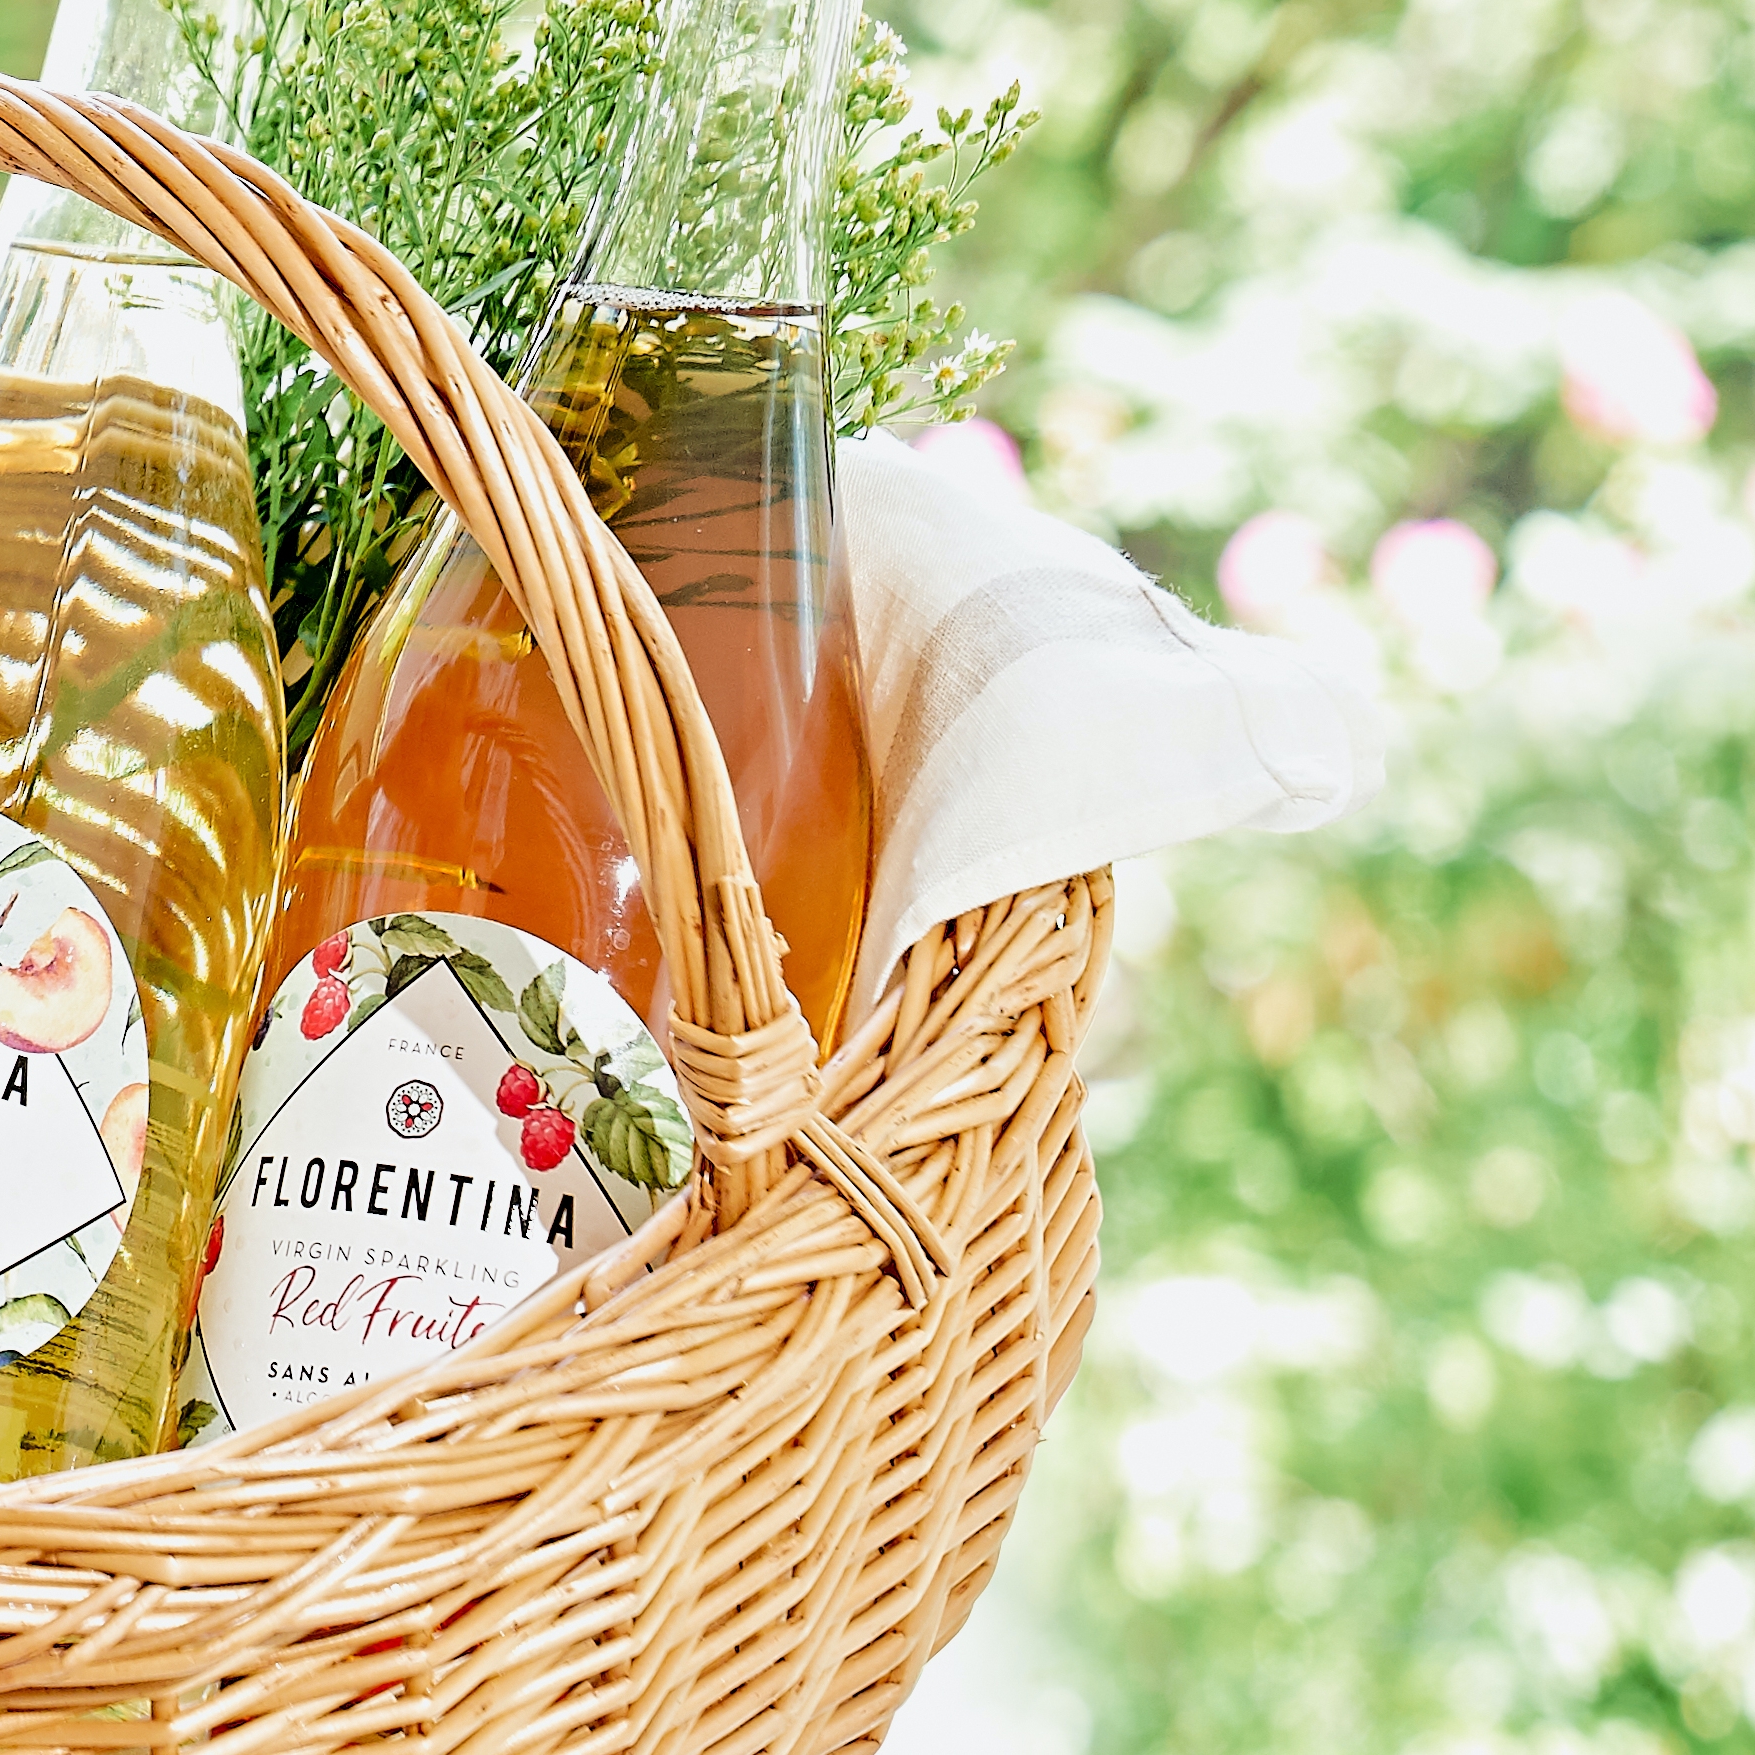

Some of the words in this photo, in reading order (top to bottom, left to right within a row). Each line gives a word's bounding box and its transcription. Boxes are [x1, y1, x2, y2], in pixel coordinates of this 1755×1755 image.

[387, 1038, 466, 1060] FRANCE
[251, 1156, 575, 1249] FLORENTINA
[272, 1239, 352, 1262] VIRGIN
[364, 1248, 520, 1289] SPARKLING
[269, 1265, 365, 1335] Red
[267, 1361, 330, 1384] SANS
